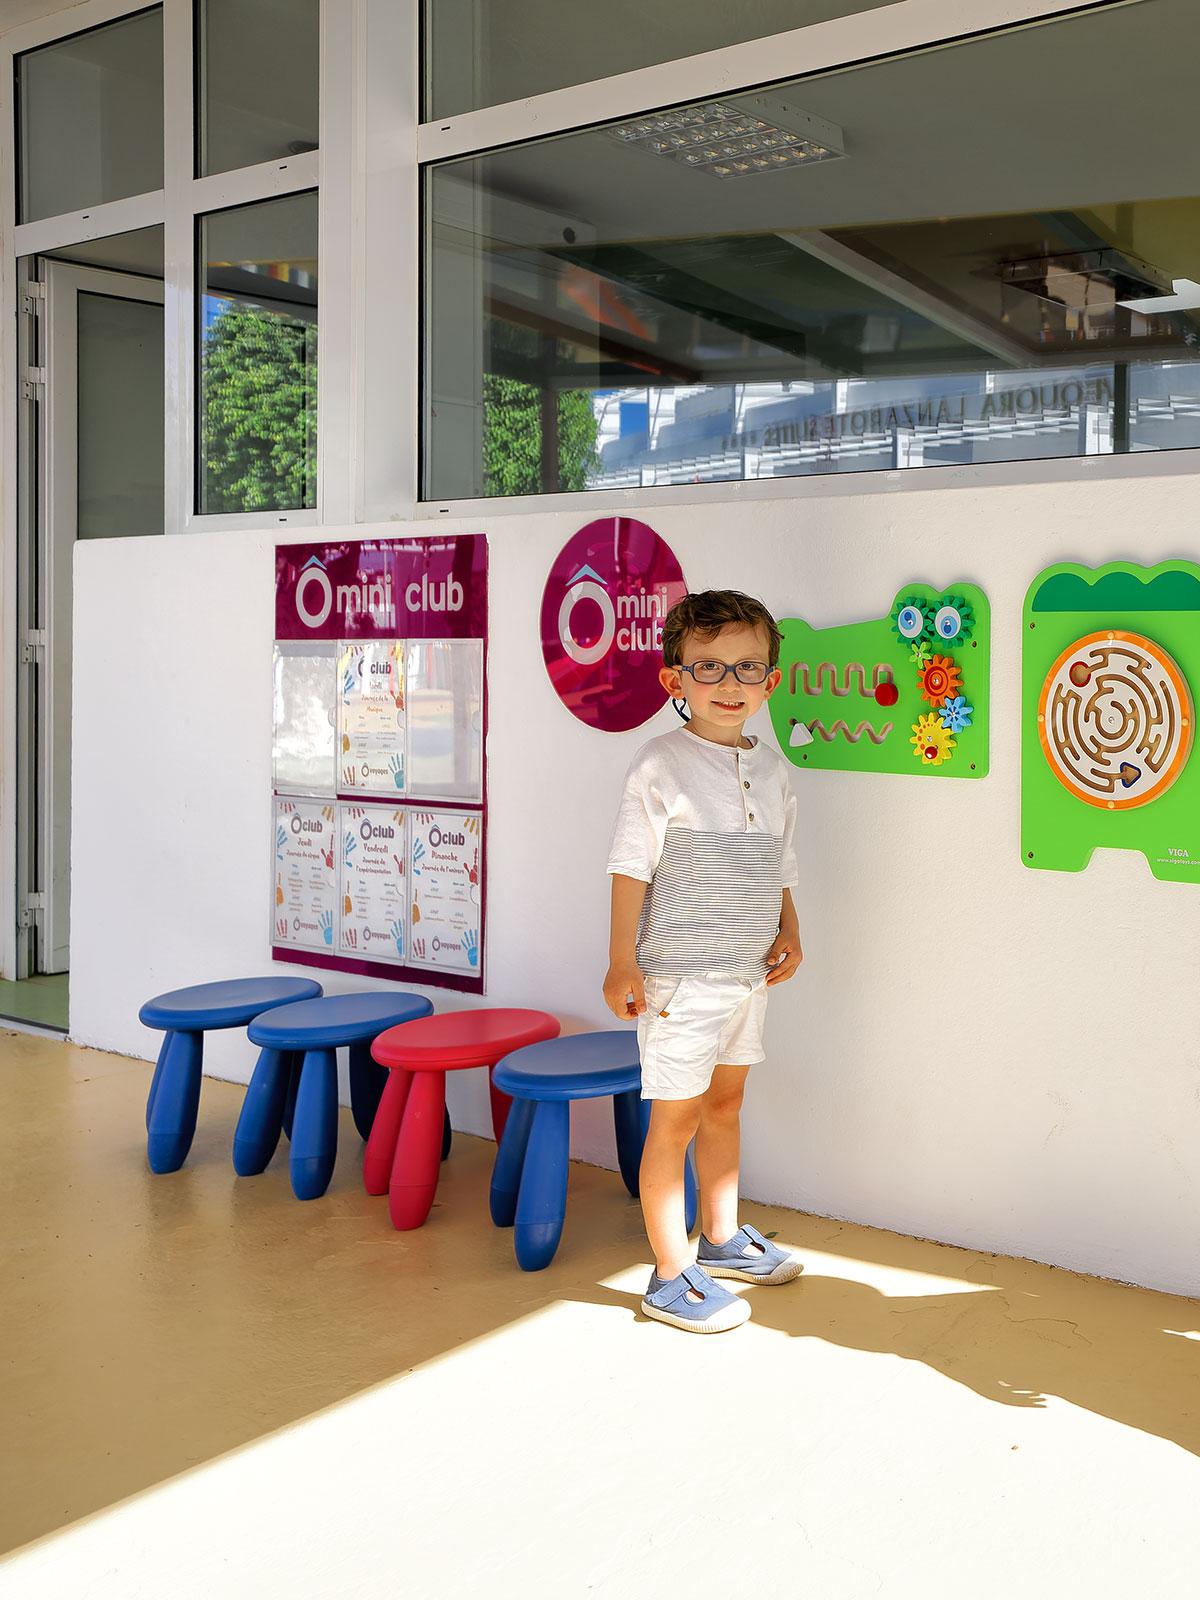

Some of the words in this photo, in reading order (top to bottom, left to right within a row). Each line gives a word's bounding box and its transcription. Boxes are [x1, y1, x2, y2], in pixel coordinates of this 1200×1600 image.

[337, 574, 392, 613] mini
[405, 572, 464, 613] club
[617, 587, 668, 619] mini
[363, 843, 389, 854] Vendredi
[1168, 848, 1190, 857] VIGA
[431, 850, 458, 862] Dimanche
